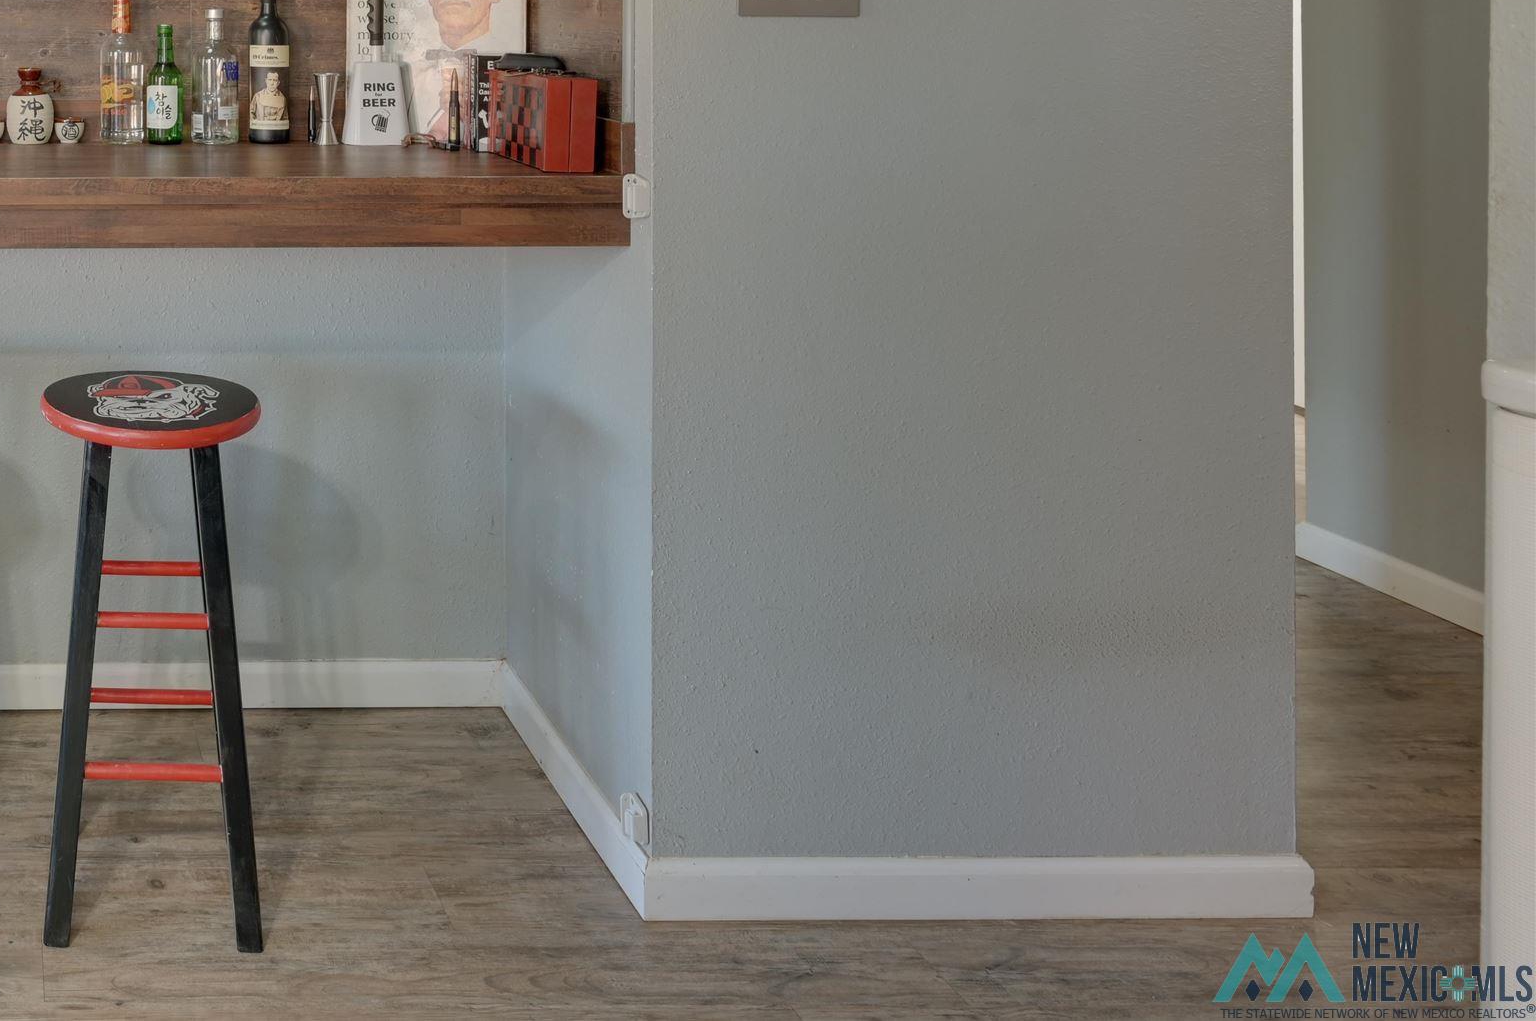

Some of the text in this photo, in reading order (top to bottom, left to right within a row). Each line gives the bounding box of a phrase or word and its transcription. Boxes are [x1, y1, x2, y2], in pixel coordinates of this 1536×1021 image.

[363, 82, 396, 92] RING
[154, 91, 173, 120] 참이슬
[362, 98, 396, 108] BEER
